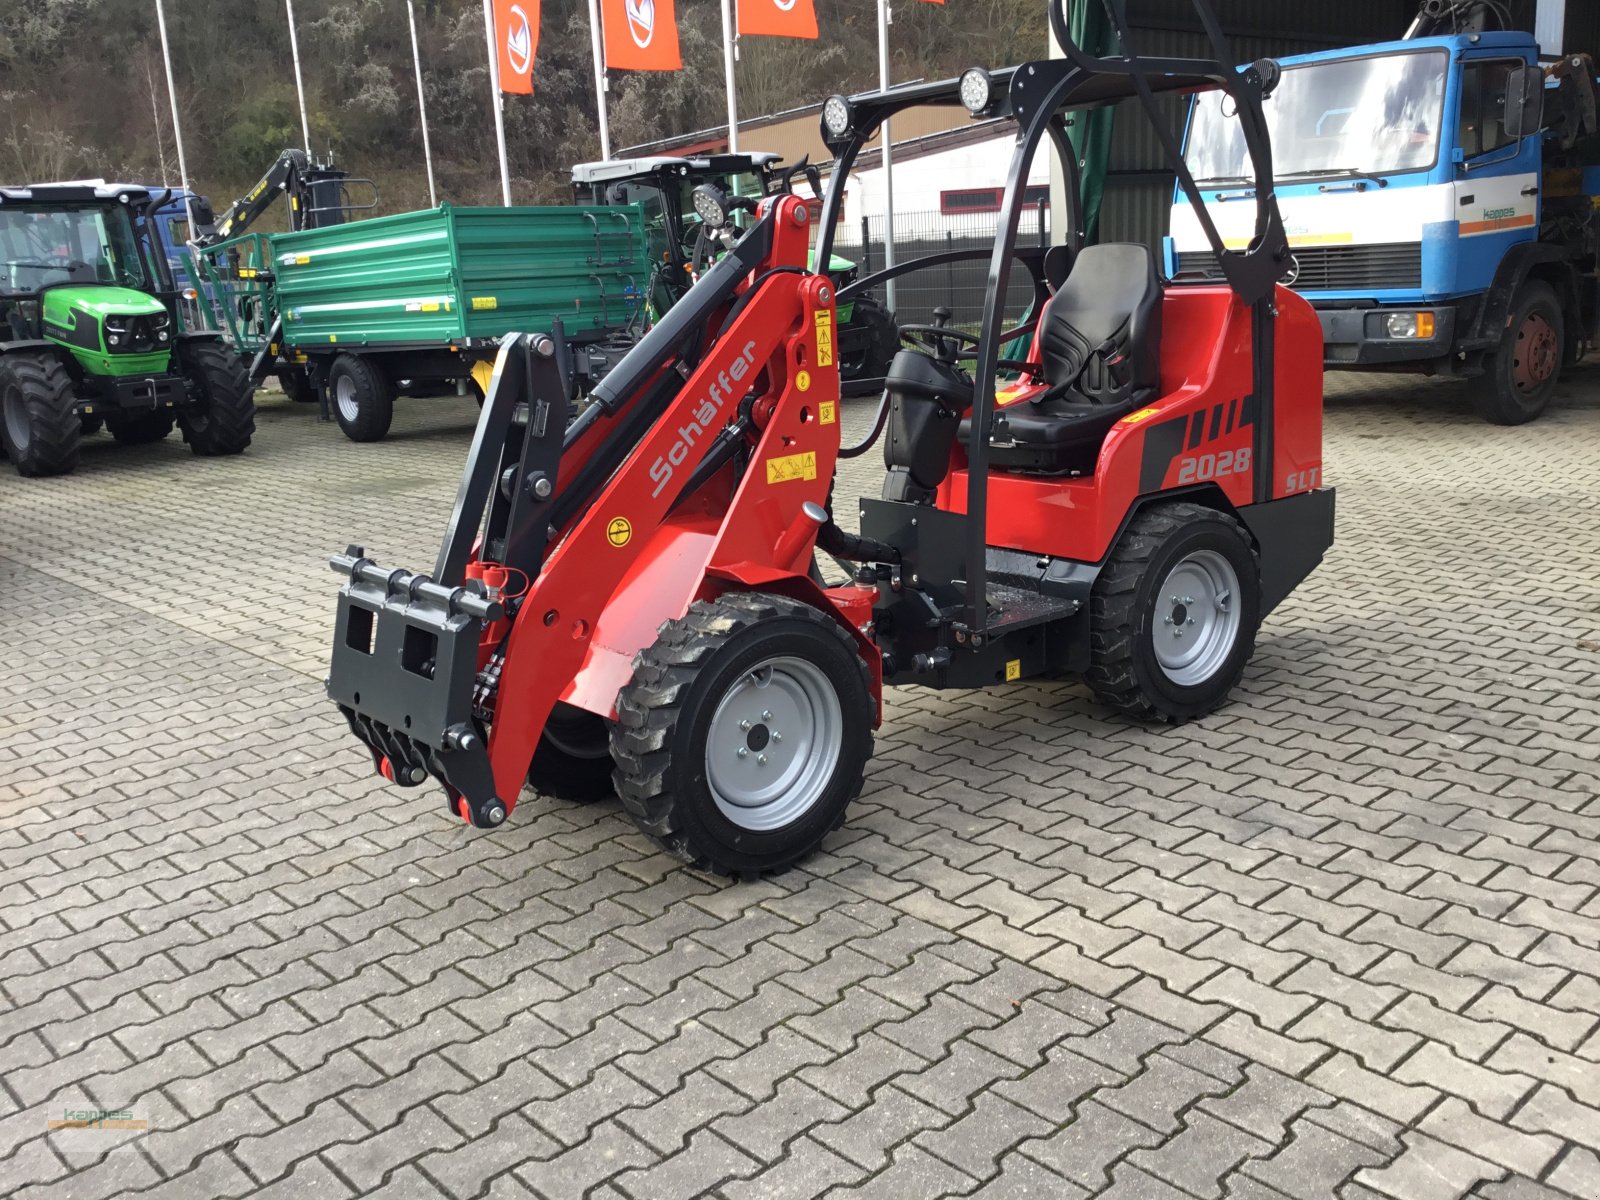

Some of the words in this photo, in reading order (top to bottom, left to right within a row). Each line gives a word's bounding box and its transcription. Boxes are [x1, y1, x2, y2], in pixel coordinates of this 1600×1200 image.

[1483, 207, 1516, 228] kappes
[649, 340, 756, 498] Schäffer
[1178, 447, 1253, 484] 2028
[1285, 468, 1319, 493] SLT
